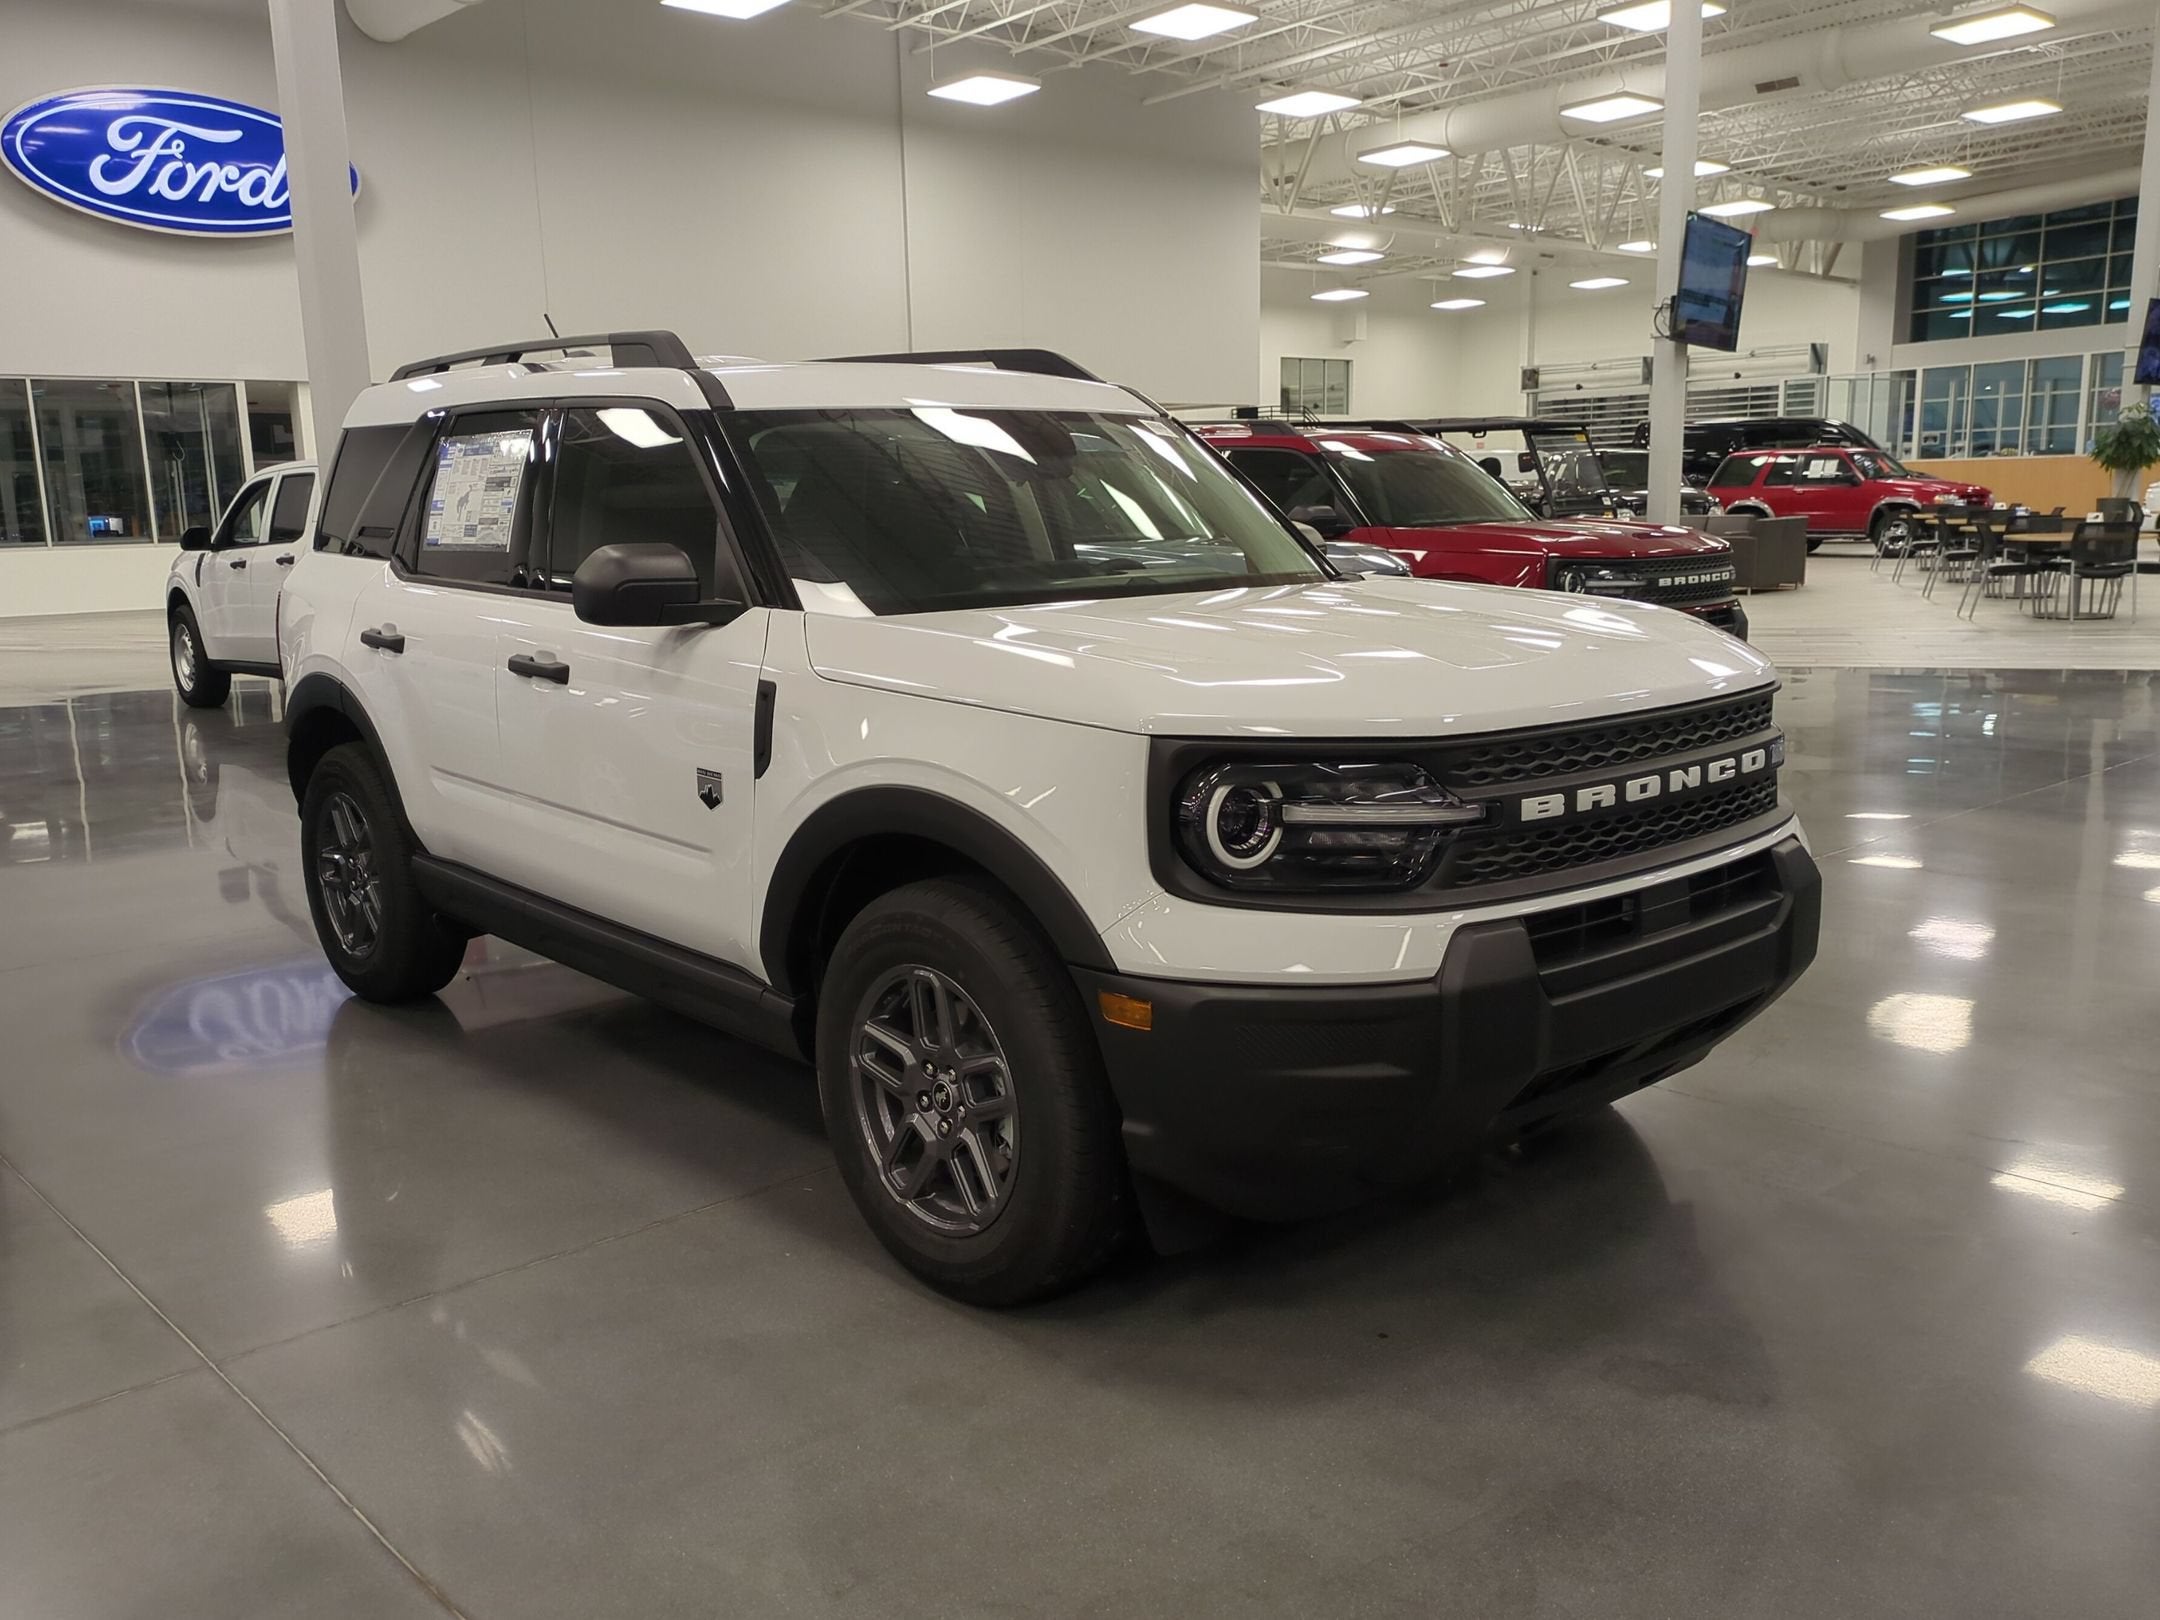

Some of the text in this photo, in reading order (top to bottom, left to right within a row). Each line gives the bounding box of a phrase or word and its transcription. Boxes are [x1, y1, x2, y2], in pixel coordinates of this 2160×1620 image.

[88, 115, 289, 209] Ford
[1658, 571, 1730, 587] BRONCO
[1520, 748, 1766, 822] BRONCO
